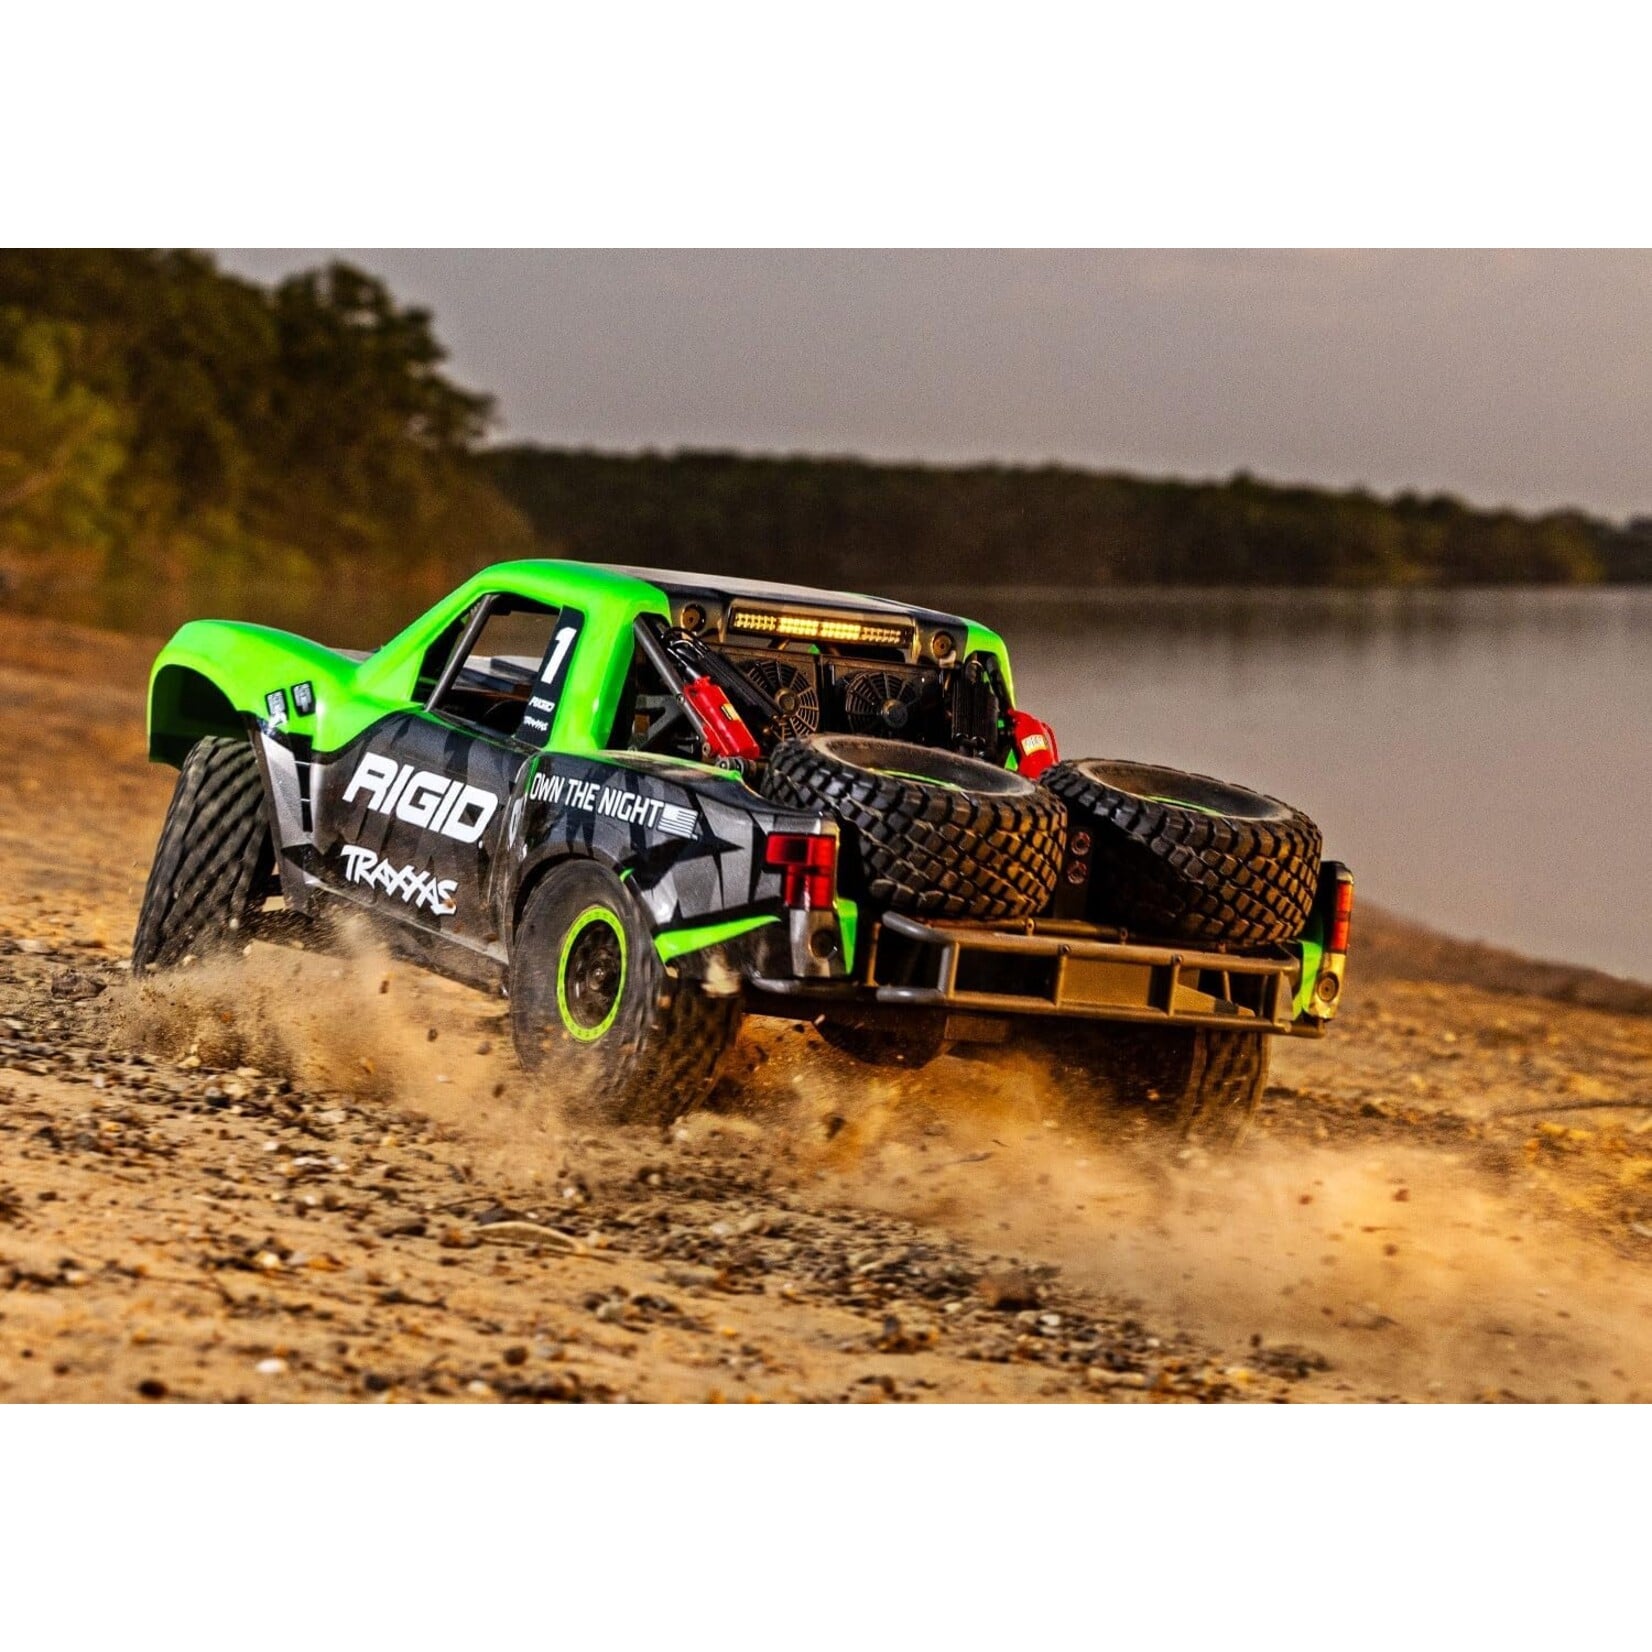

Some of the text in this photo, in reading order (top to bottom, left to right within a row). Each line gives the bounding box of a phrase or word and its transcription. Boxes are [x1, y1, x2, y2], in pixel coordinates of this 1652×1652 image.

[541, 626, 577, 684] 1
[342, 752, 499, 844] RIGID
[529, 772, 665, 828] OWN THE NIGHT
[340, 844, 458, 916] TRAXXAS
